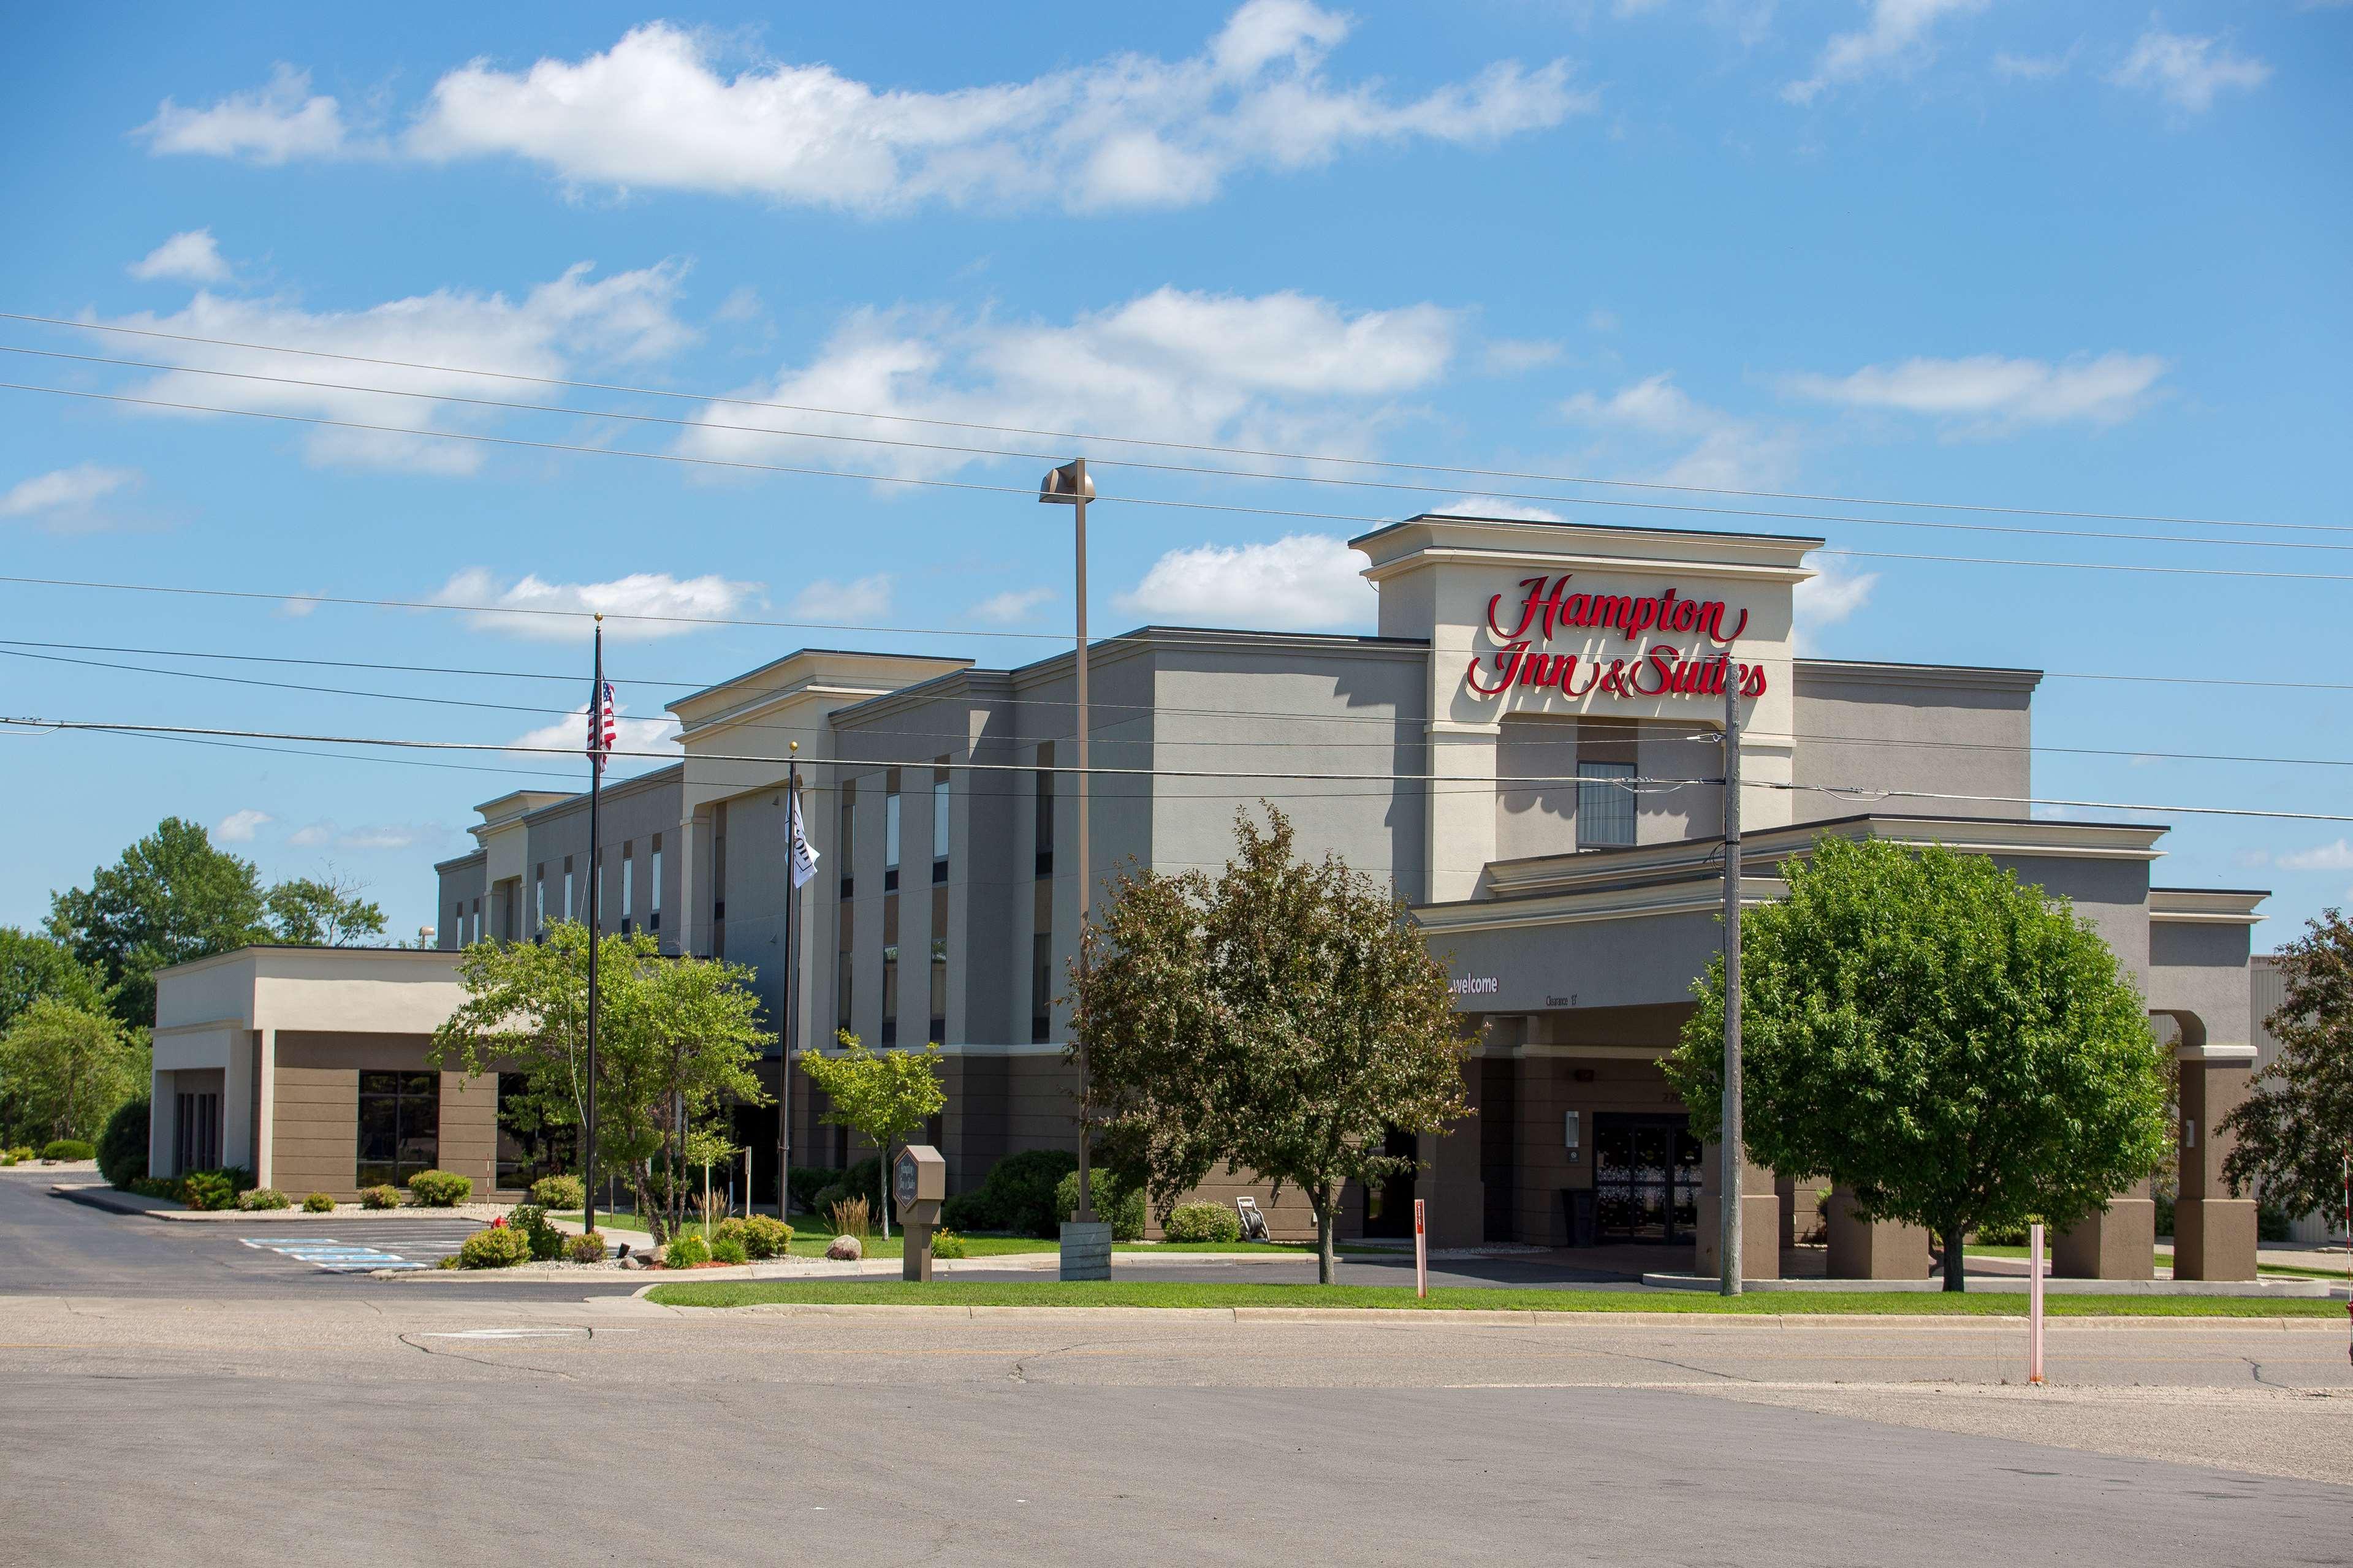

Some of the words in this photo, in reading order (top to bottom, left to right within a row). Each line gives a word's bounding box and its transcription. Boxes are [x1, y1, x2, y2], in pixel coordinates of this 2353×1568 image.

[1488, 574, 1748, 643] Hampton
[1467, 640, 1600, 697] Inn
[1600, 658, 1635, 699] &
[1631, 645, 1767, 697] Suites
[1453, 972, 1498, 994] welcome
